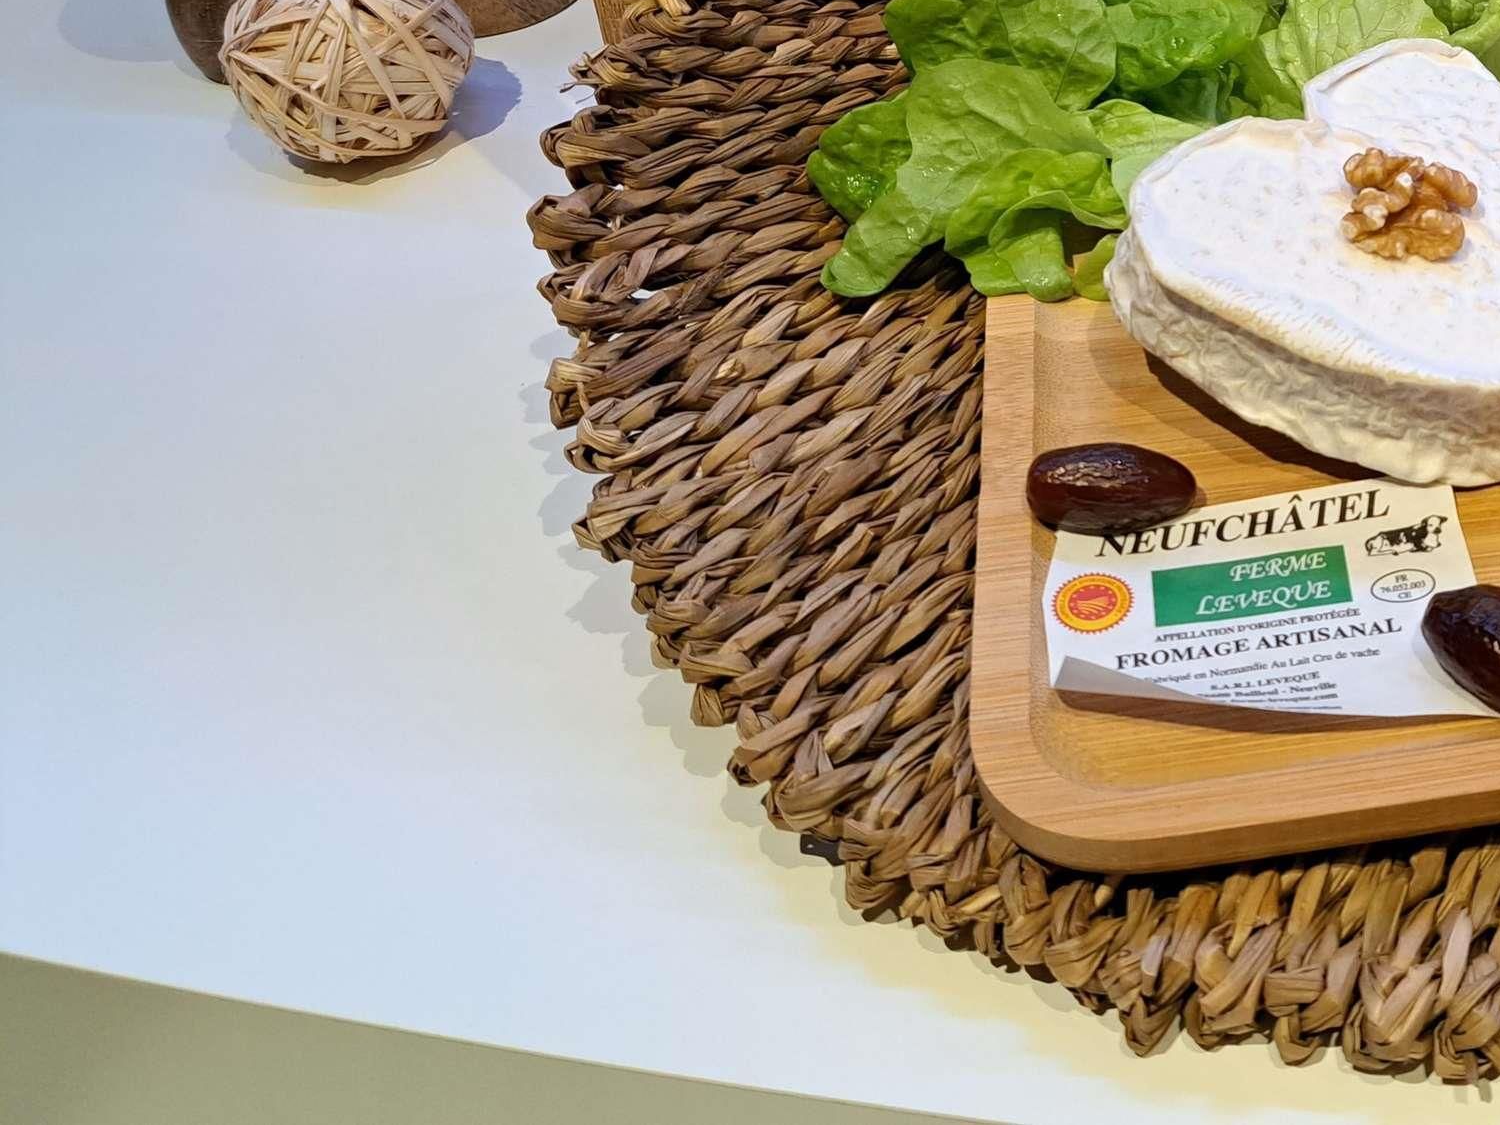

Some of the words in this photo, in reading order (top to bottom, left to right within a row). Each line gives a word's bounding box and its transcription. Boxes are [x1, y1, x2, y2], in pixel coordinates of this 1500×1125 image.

[1095, 488, 1390, 557] NEUFCHÂTEL
[1230, 551, 1328, 581] FERME
[1196, 579, 1331, 615] LEVEQUE
[1154, 624, 1235, 643] APPELLATION
[1236, 617, 1298, 633] D'ORIGINE
[1299, 607, 1361, 624] PROTÉGÉE
[1115, 637, 1251, 671] FROMAGE
[1255, 617, 1403, 651] ARTISANAL
[1194, 672, 1208, 680] en
[1209, 661, 1268, 678] Normandie
[1270, 659, 1287, 669] Au
[1289, 656, 1311, 667] Lait
[1312, 653, 1333, 663] Cru
[1334, 650, 1348, 659] de
[1349, 647, 1381, 658] vache
[1257, 671, 1320, 687] LEVEQUE
